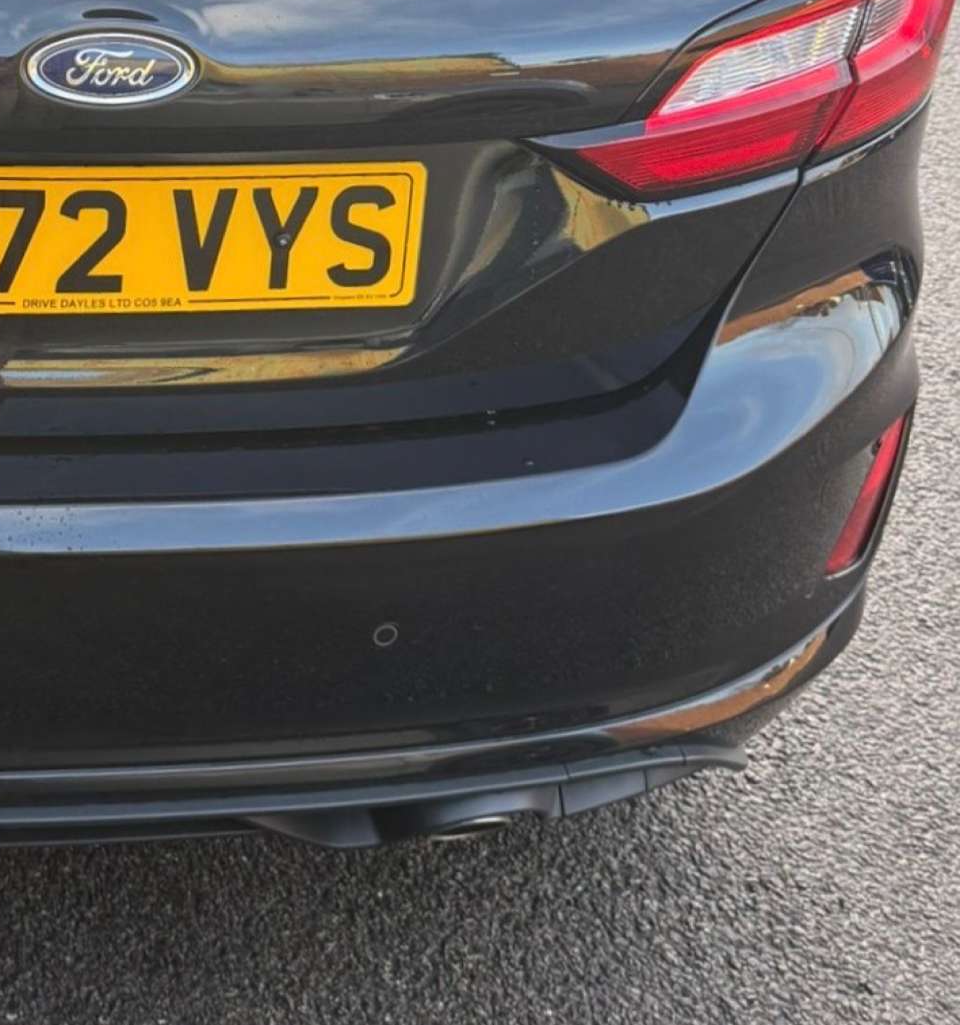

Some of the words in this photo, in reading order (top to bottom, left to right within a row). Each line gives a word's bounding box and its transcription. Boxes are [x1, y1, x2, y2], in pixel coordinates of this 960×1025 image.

[66, 48, 153, 87] Ford
[172, 184, 397, 291] VYS
[22, 298, 57, 309] DRIVE
[60, 298, 106, 309] DAYLES
[109, 298, 131, 308] LTD
[160, 297, 182, 307] 9EA
